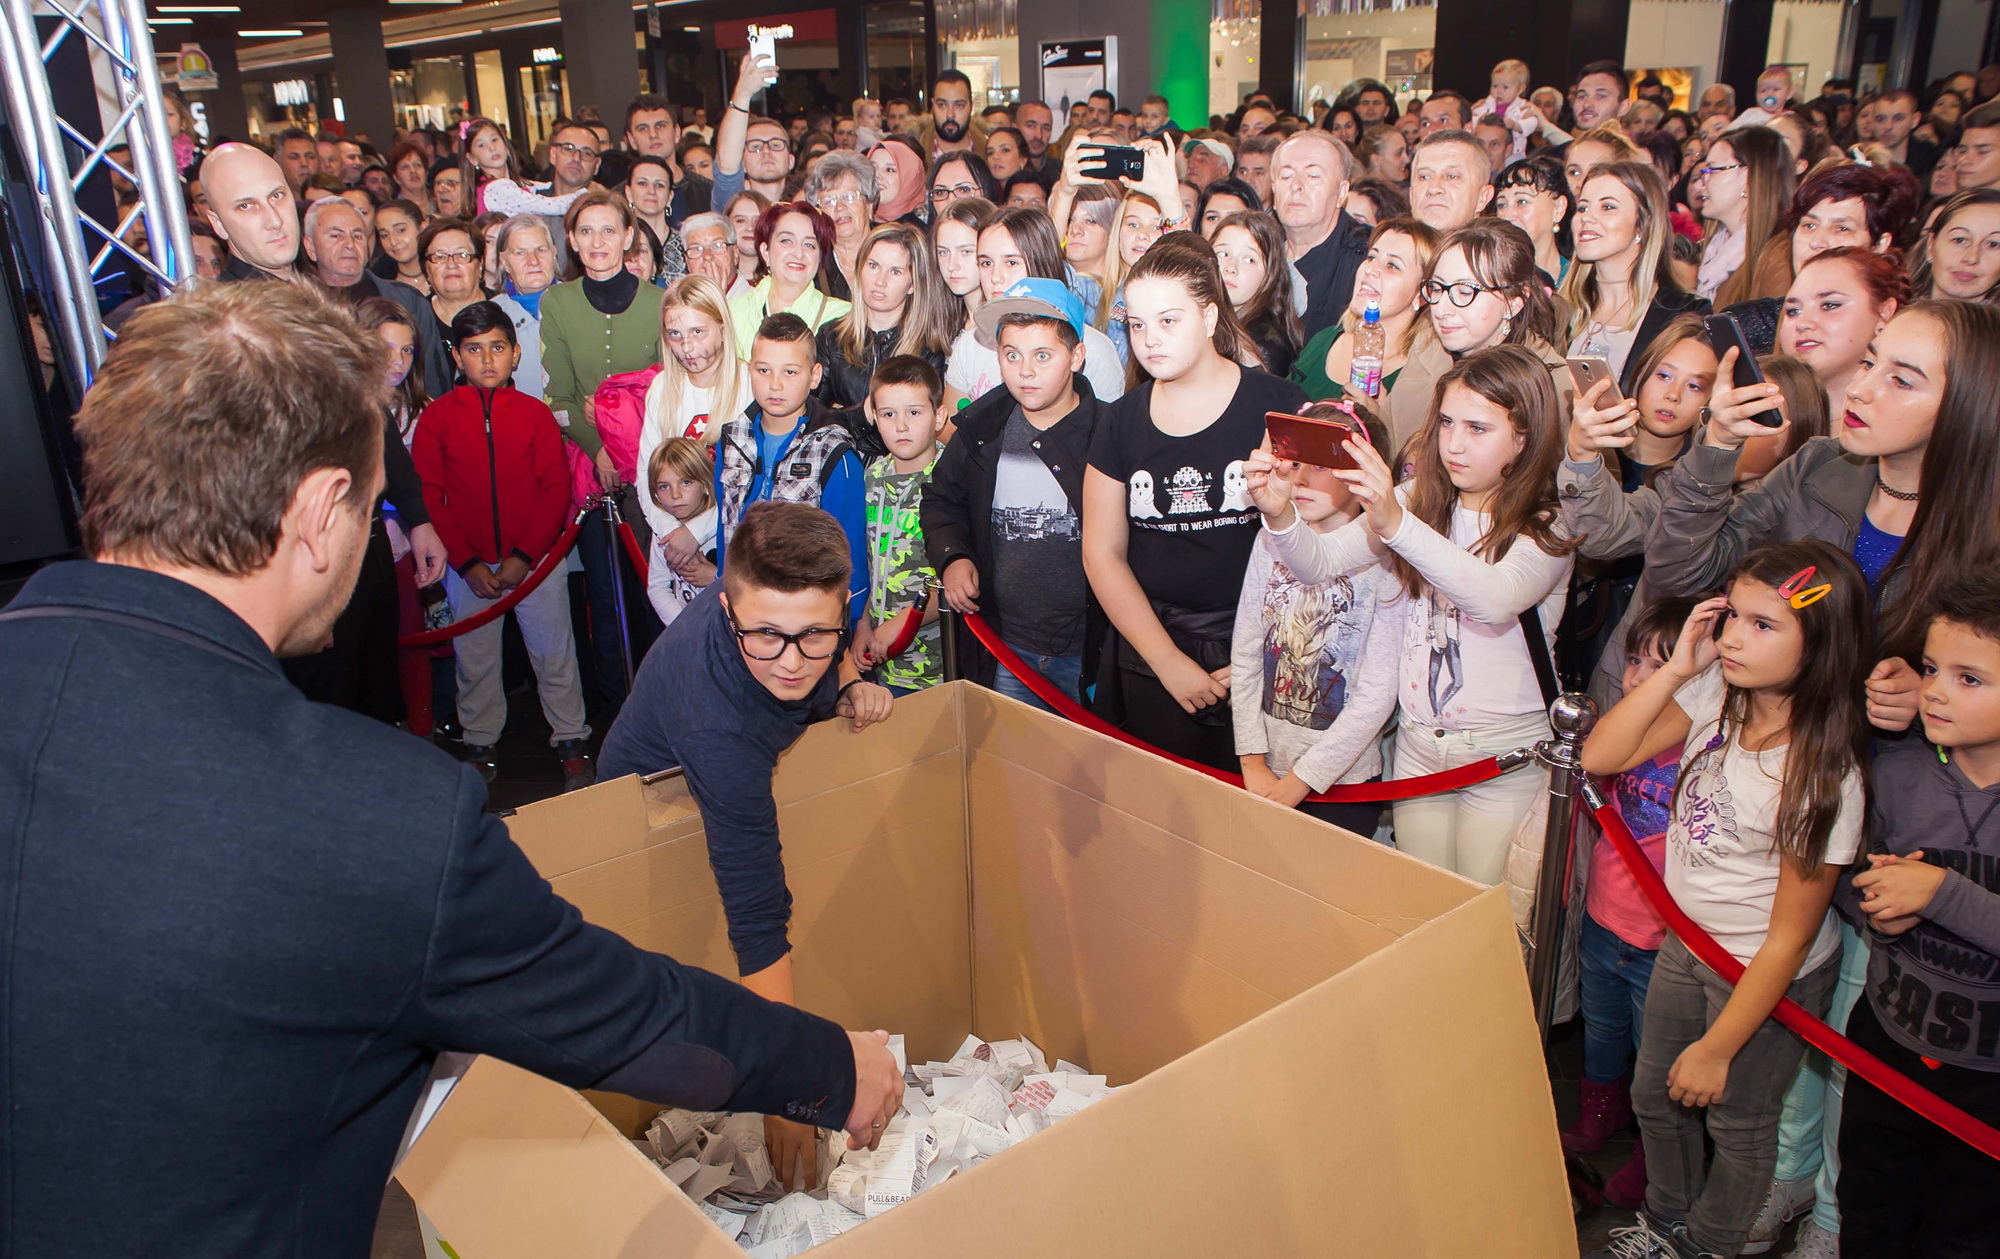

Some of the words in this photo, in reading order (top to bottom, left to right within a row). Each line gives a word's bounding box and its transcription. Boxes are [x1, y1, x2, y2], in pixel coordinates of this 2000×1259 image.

[1180, 523, 1189, 531] TO
[1191, 520, 1213, 531] WEAR
[1214, 516, 1237, 527] BORING
